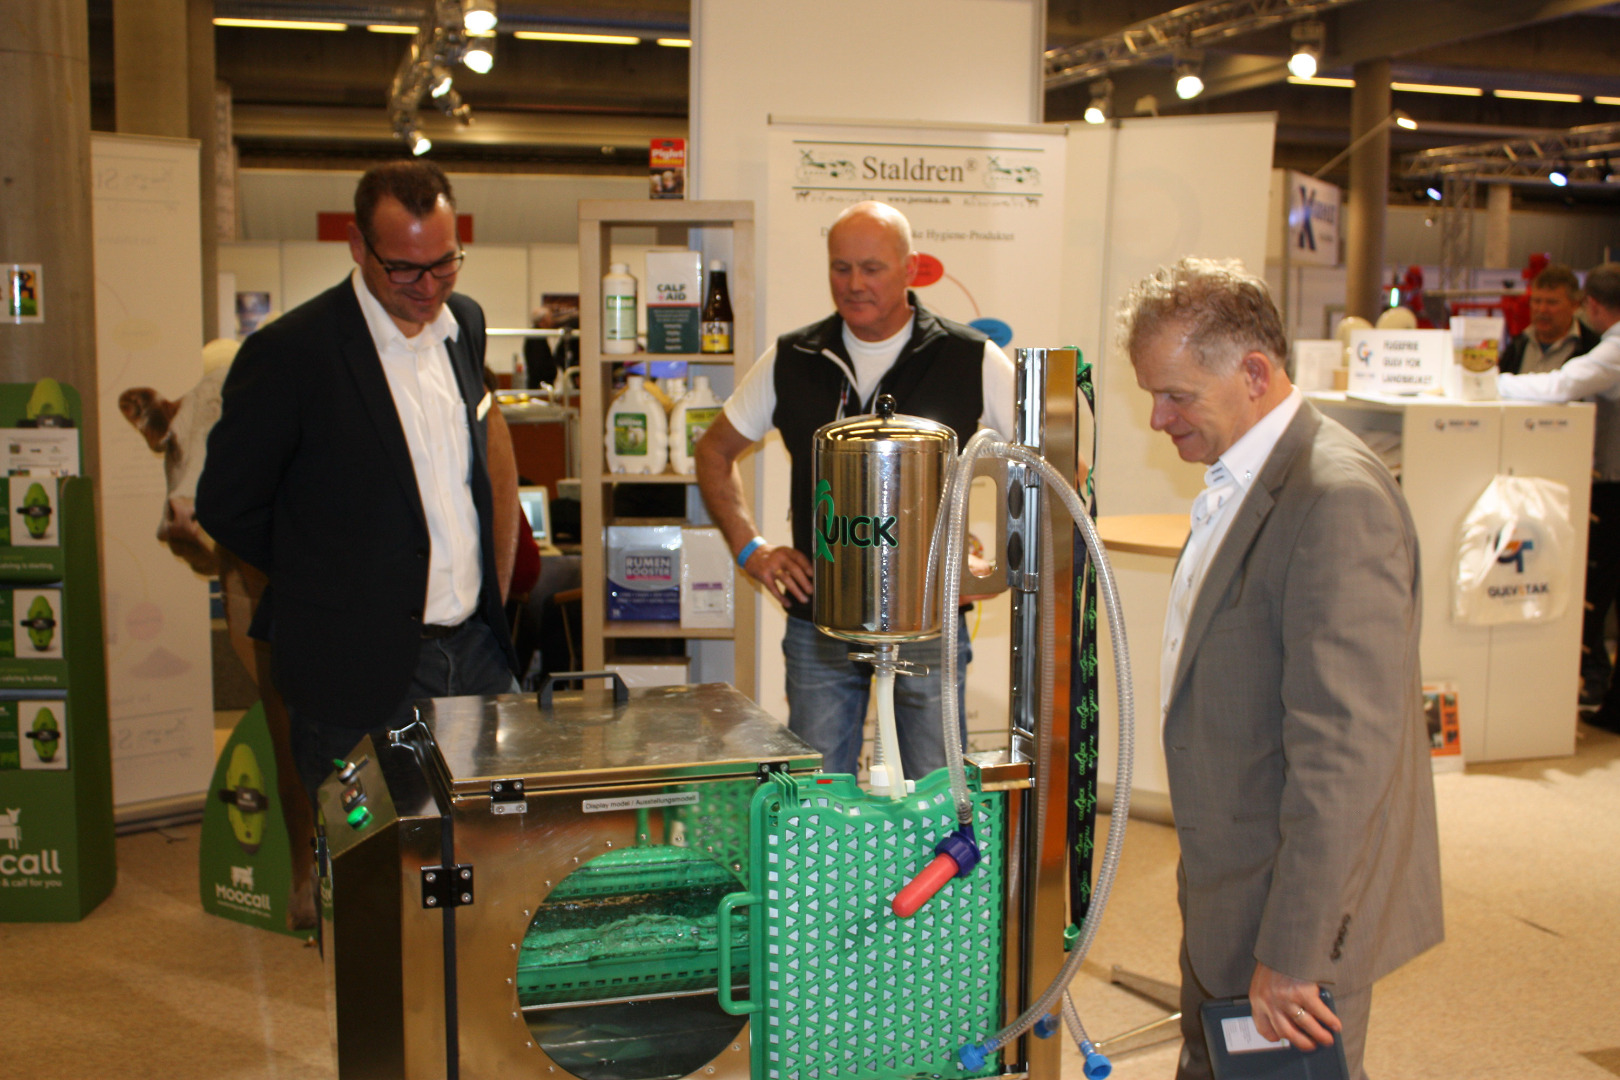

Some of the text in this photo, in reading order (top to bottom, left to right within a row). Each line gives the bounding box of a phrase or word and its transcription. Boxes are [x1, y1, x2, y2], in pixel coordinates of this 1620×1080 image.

[657, 284, 686, 292] CALF
[626, 556, 671, 568] RUMEN
[626, 567, 670, 576] BOOSTER
[585, 802, 609, 810] Display
[215, 882, 271, 911] Moocall
